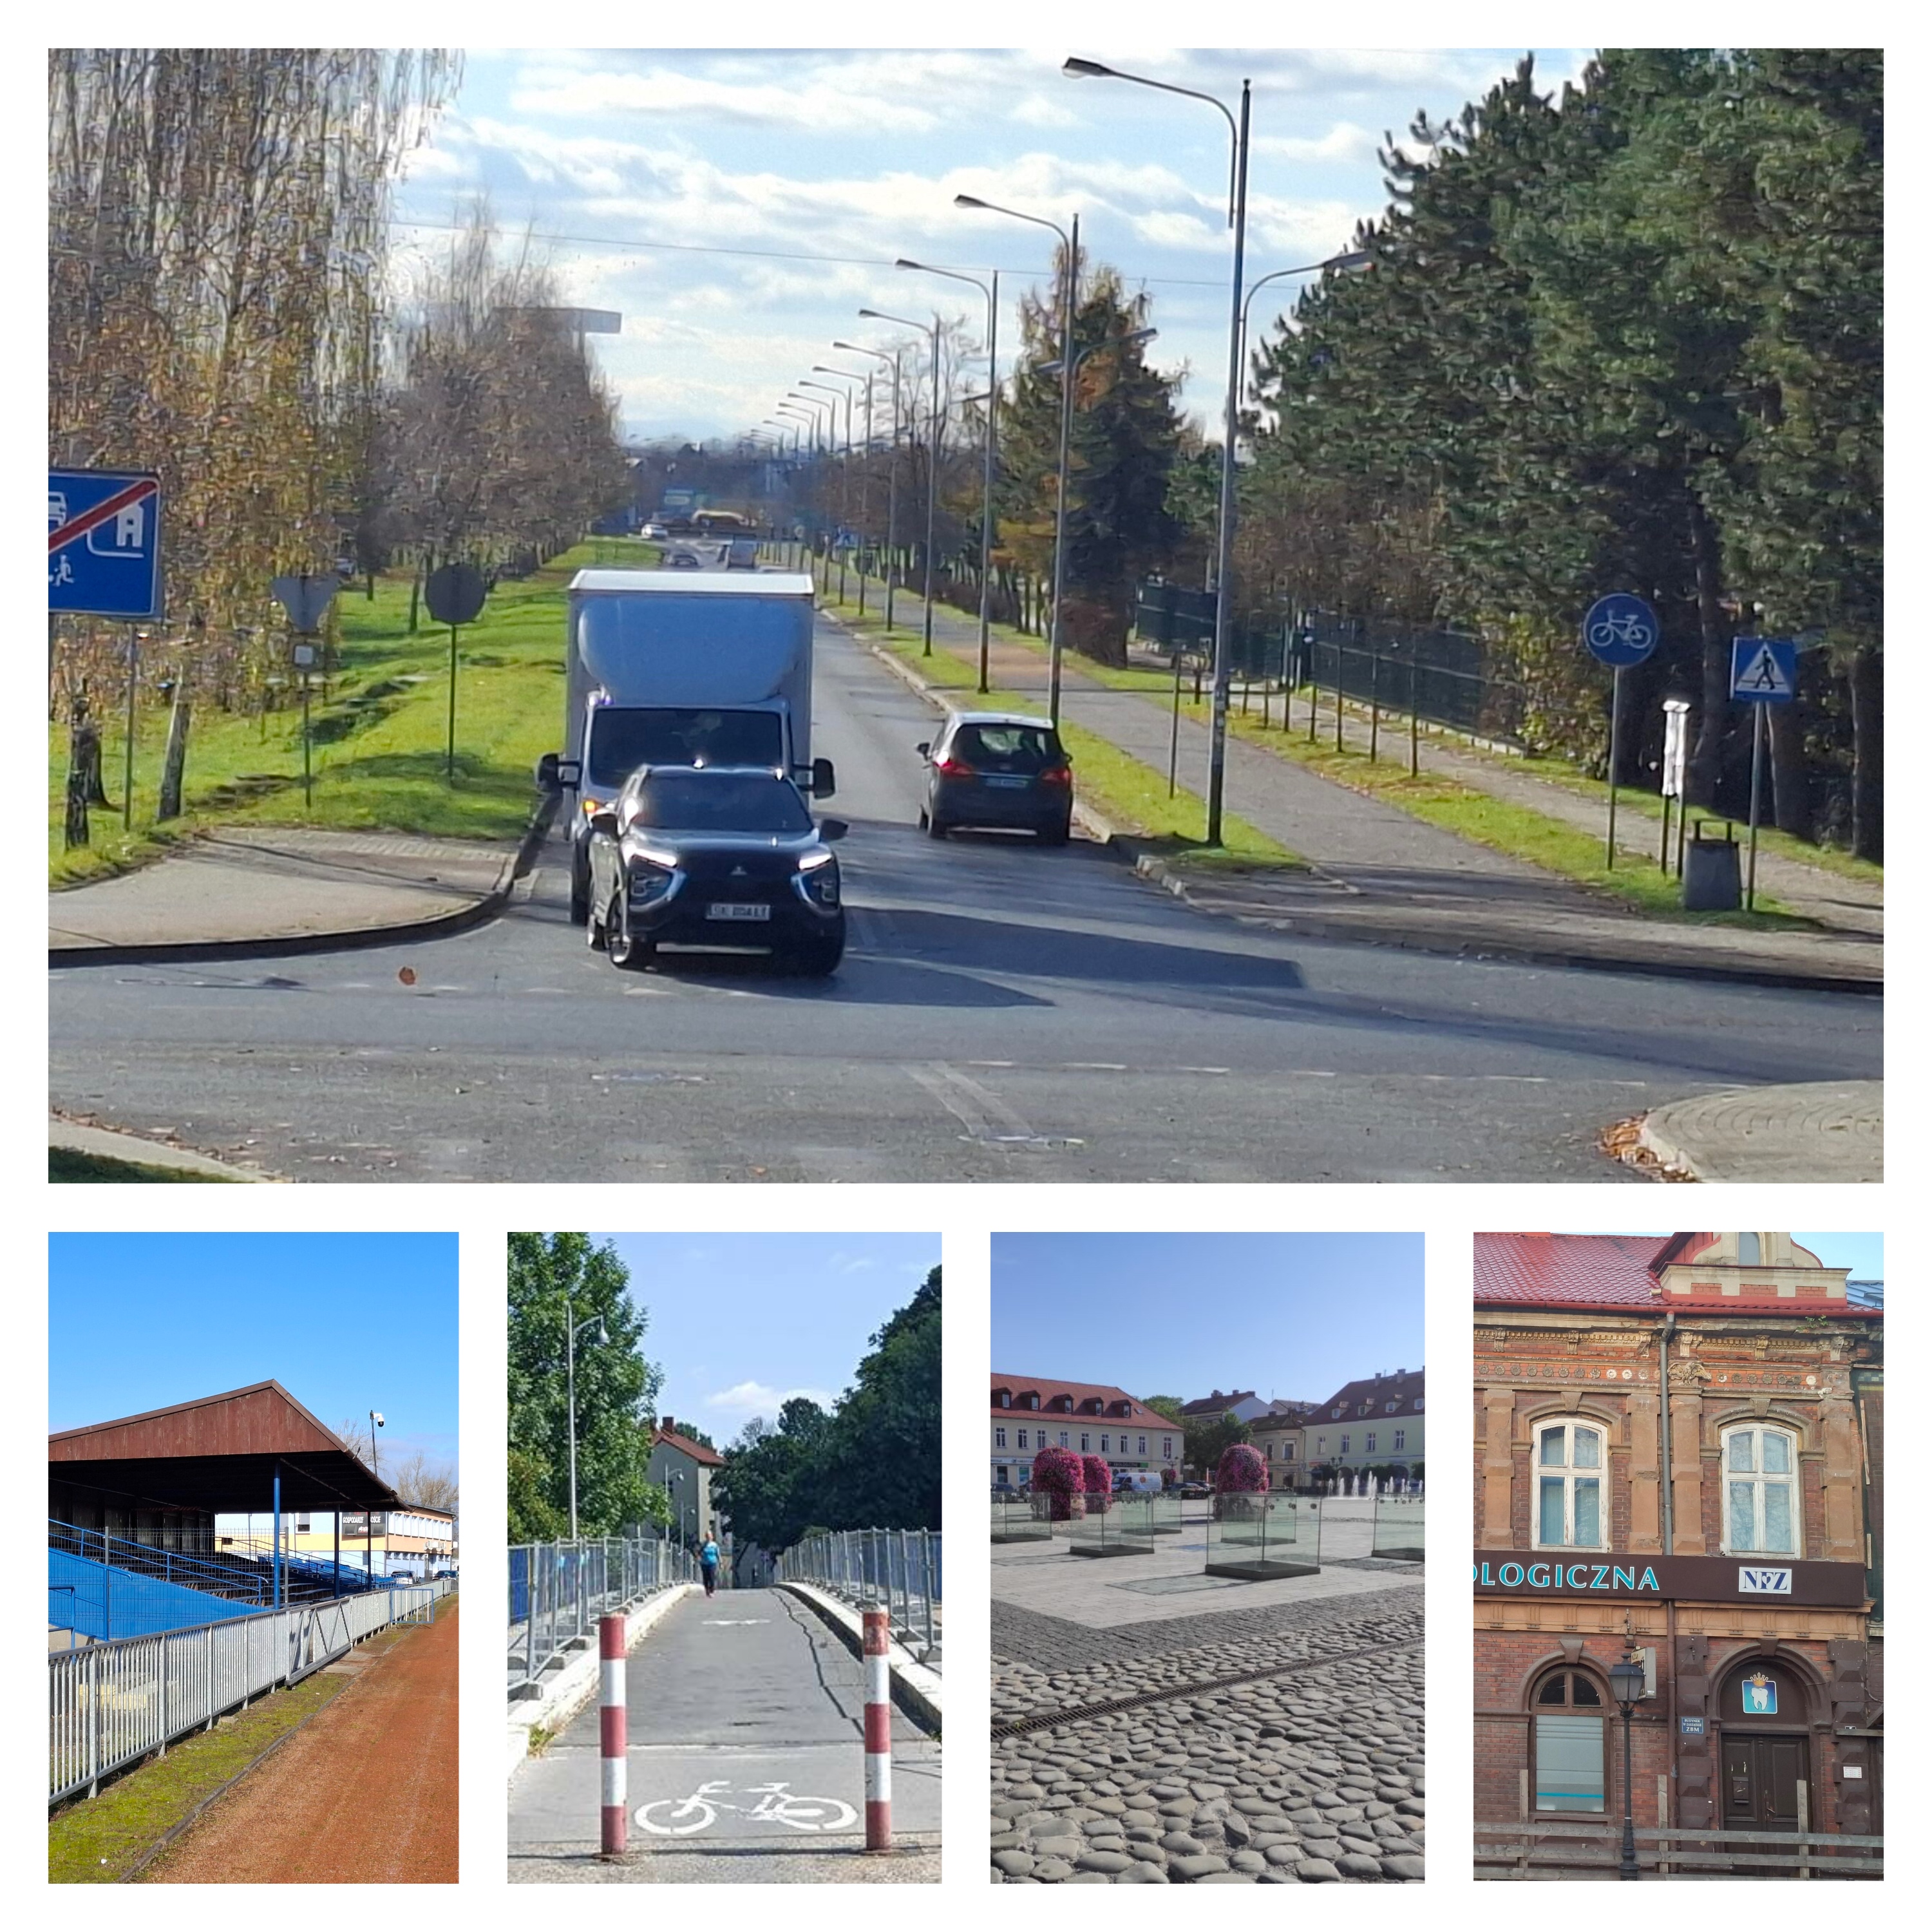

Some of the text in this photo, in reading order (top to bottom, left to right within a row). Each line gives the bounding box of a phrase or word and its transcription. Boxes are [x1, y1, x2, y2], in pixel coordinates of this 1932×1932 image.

[370, 1515, 381, 1524] OŚCIE
[1473, 1562, 1660, 1591] LOGICZNA
[1743, 1571, 1788, 1590] NFZ
